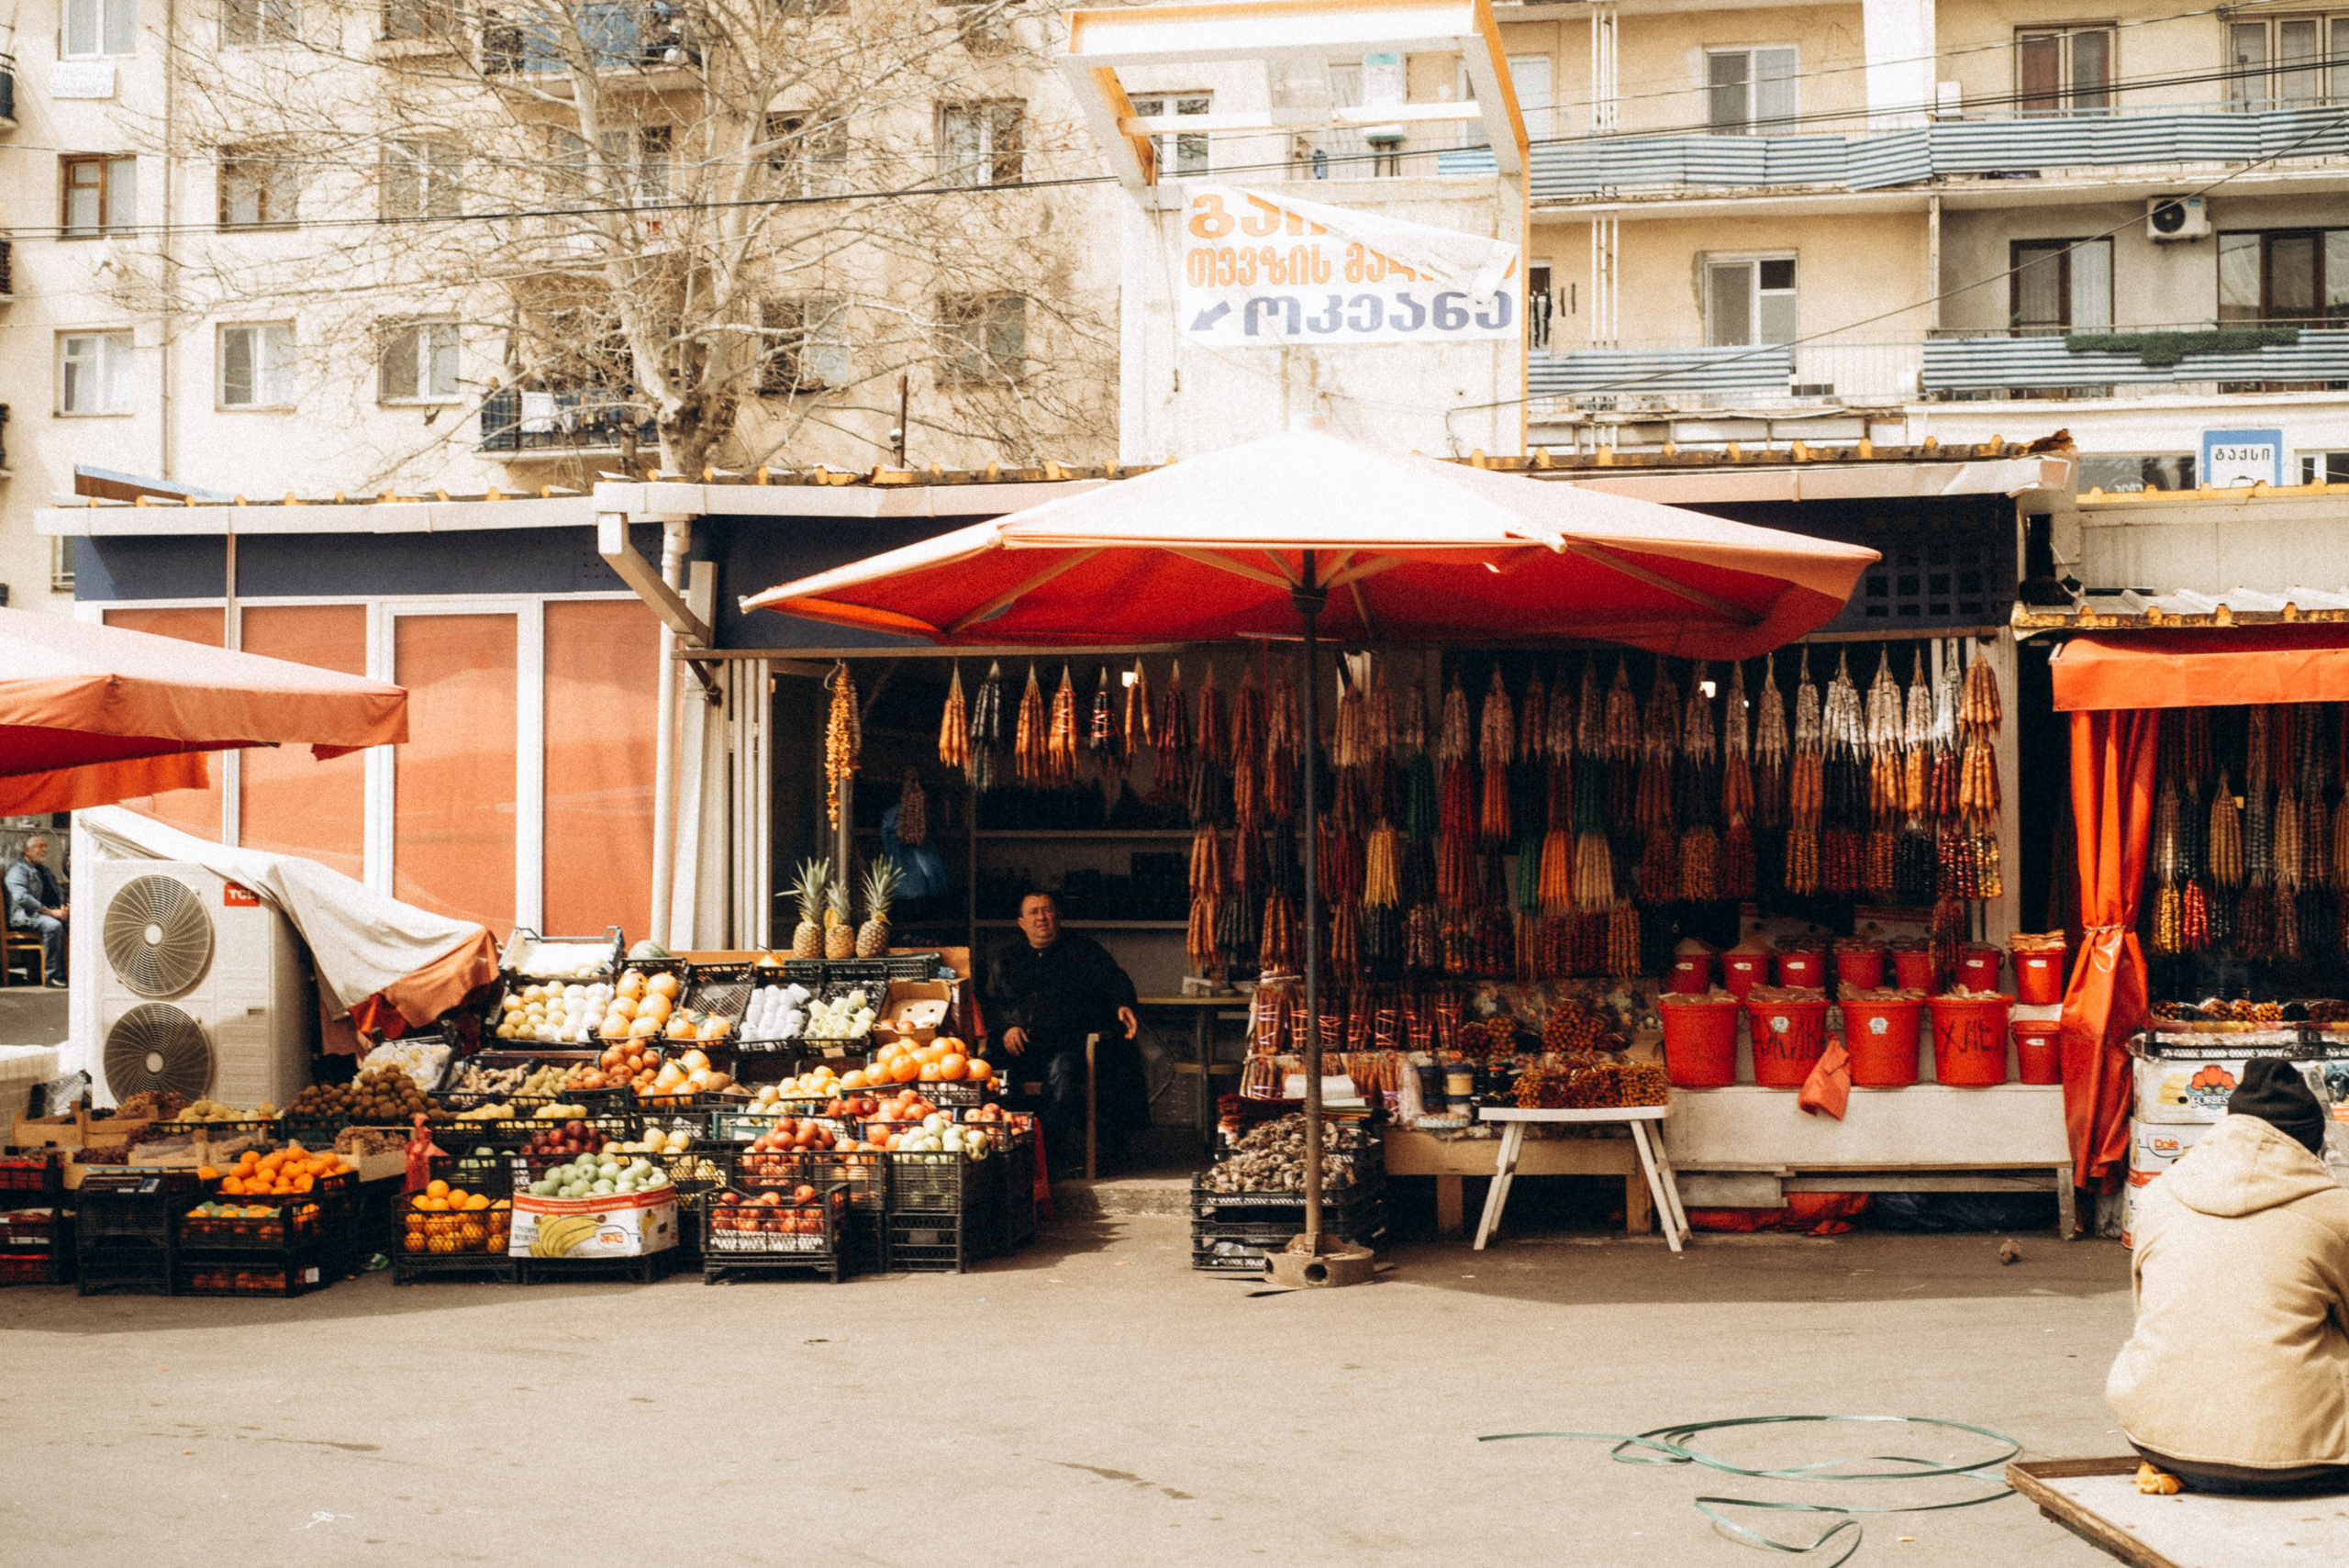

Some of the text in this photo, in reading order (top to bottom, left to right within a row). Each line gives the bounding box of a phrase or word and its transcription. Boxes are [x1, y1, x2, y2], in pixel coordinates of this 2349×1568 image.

[1187, 244, 1331, 287] თევზის
[1244, 291, 1512, 336] ოკეანე
[2215, 448, 2270, 461] ტაქსი
[228, 889, 256, 900] TCL
[2154, 1139, 2179, 1151] Dole
[600, 1232, 623, 1244] Dole
